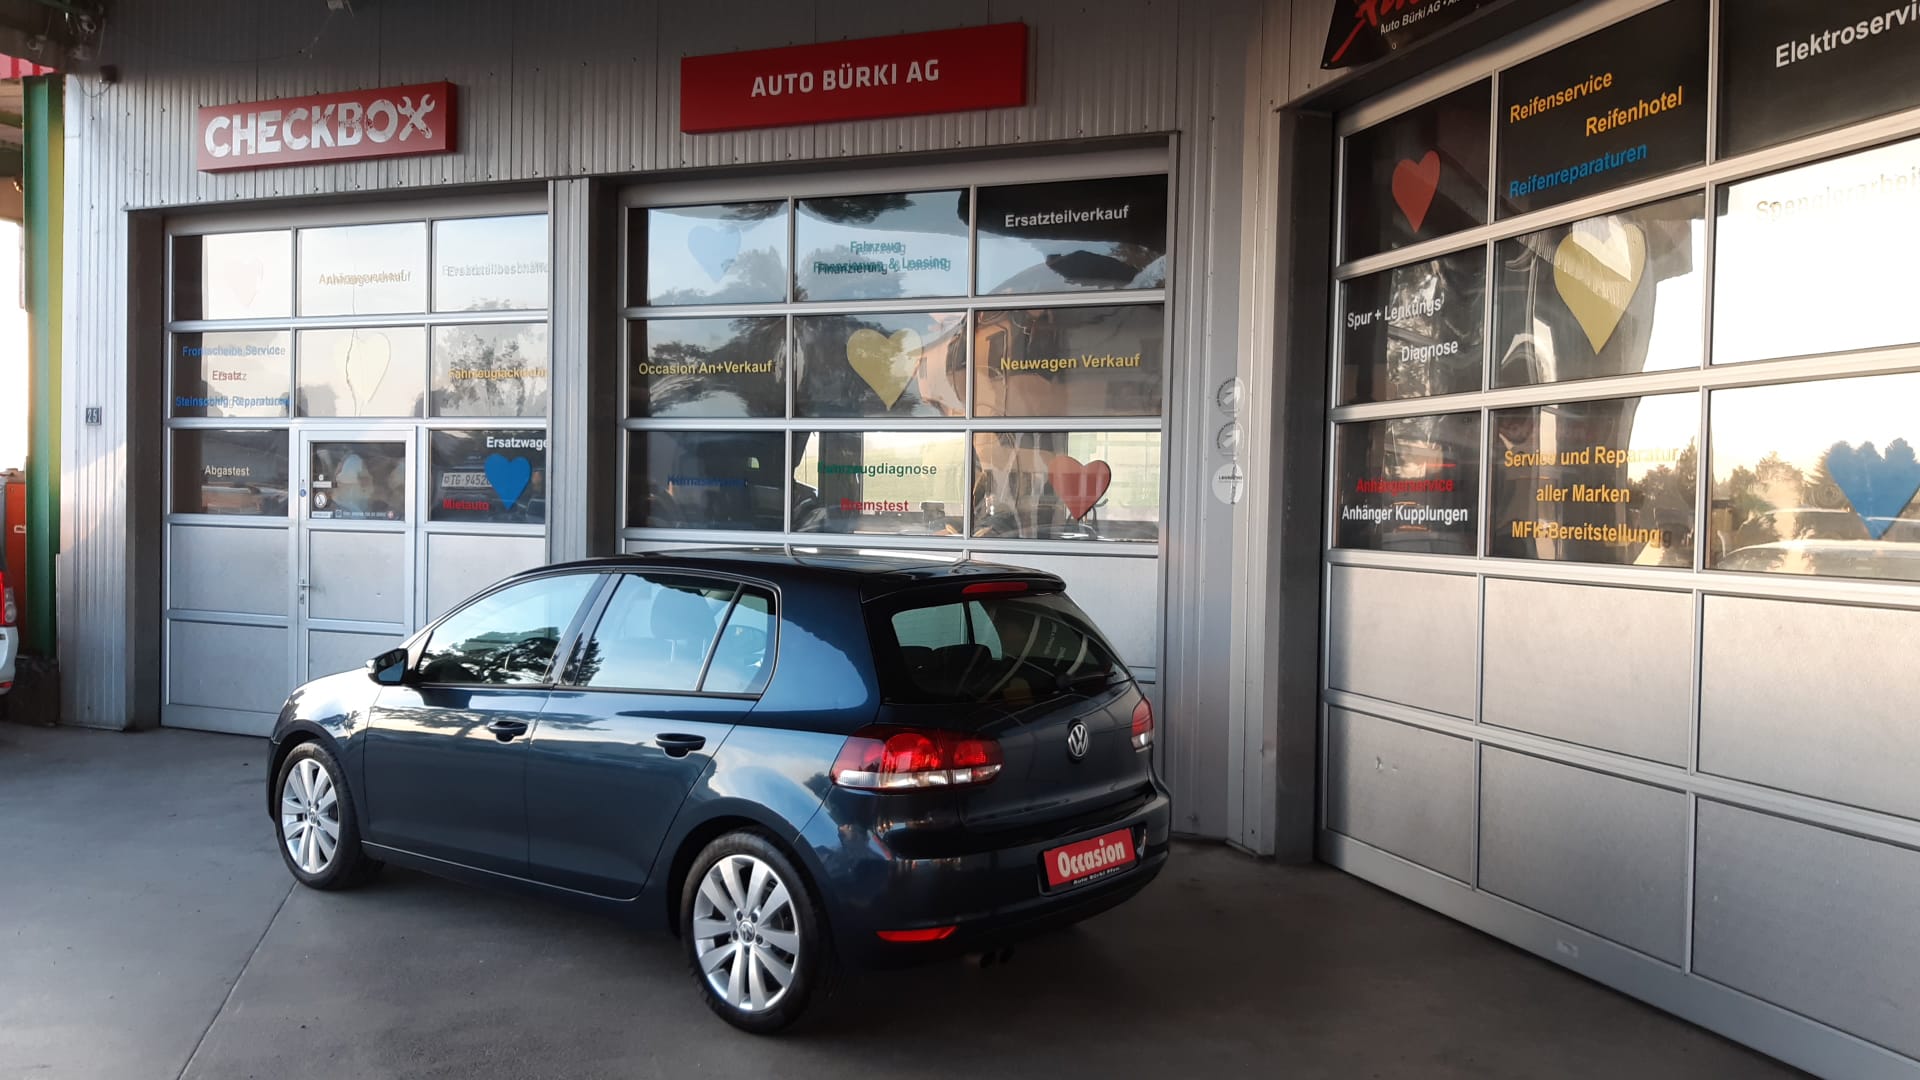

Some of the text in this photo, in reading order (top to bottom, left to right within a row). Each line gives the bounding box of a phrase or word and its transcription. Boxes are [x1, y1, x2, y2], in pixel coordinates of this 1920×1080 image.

[1380, 20, 1400, 37] Auto
[1402, 7, 1426, 27] Bürki
[1426, 1, 1441, 17] AG
[1776, 0, 1920, 68] Elektroservi
[751, 59, 939, 97] AUTO BÜRKI AG
[1510, 72, 1613, 124] Reifenservice
[1585, 85, 1684, 137] Reifenhotel
[1509, 144, 1648, 198] Reifenreparaturen
[1004, 205, 1129, 228] Ersatzteilverkauf
[1347, 312, 1372, 330] Spur
[1374, 309, 1382, 321] +
[1401, 341, 1458, 361] Diagnose
[638, 360, 773, 375] Occasion An+Verkauf
[1000, 353, 1140, 372] Neuwagen Verkauf
[1504, 448, 1556, 467] Service
[1560, 447, 1590, 465] und
[204, 464, 250, 477] Abgastest
[817, 462, 937, 477] Fahrzeugdiagnose
[1357, 477, 1455, 496] Anhängerservice
[1536, 484, 1631, 502] aller Marken
[442, 499, 490, 511] Mietauto
[840, 498, 909, 512] Bremstest
[1342, 504, 1469, 525] Anhänger Kupplungen
[1057, 838, 1125, 878] Occasion
